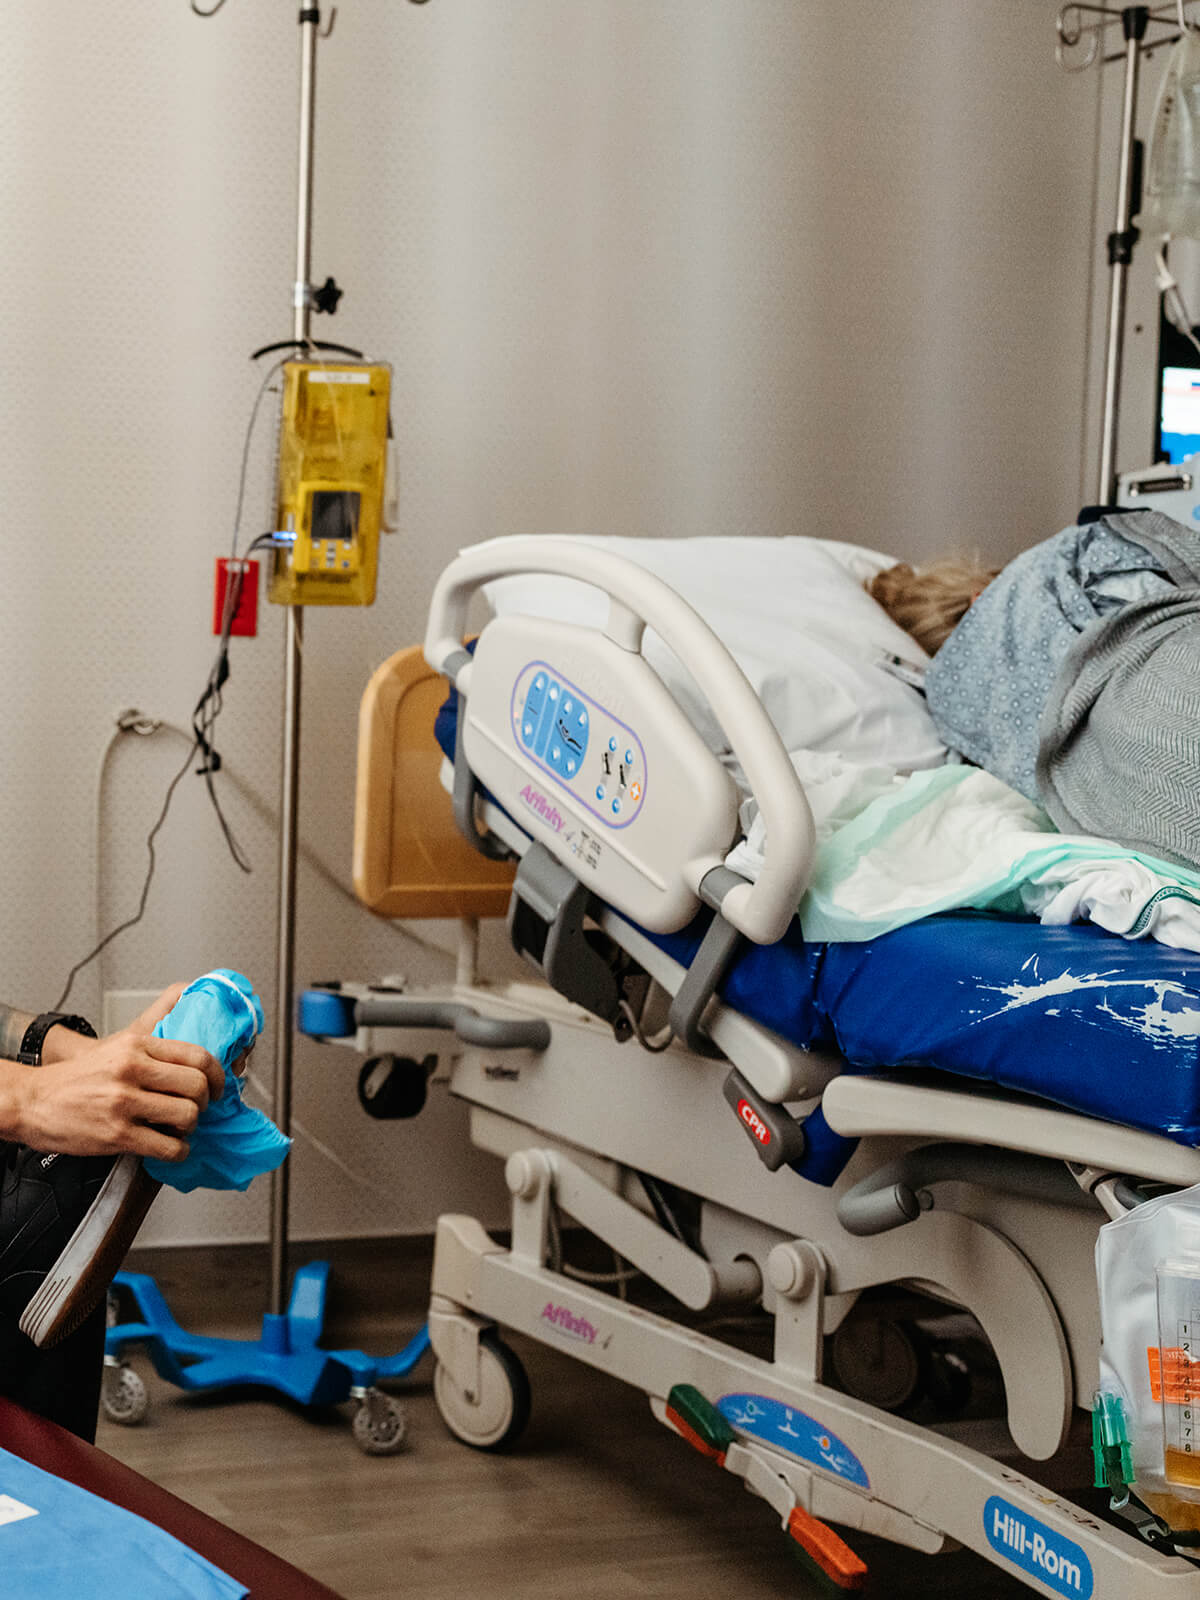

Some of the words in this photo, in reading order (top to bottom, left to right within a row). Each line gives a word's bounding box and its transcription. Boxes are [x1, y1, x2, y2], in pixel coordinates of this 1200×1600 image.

[520, 784, 565, 832] Affinity
[741, 1105, 766, 1140] CPR
[541, 1302, 598, 1344] Affinity
[1183, 1342, 1190, 1351] 2
[1184, 1393, 1191, 1402] 5
[1184, 1410, 1191, 1419] 6
[1185, 1427, 1191, 1437] 7
[1185, 1444, 1191, 1453] 8
[993, 1508, 1081, 1590] Hill-Rom
